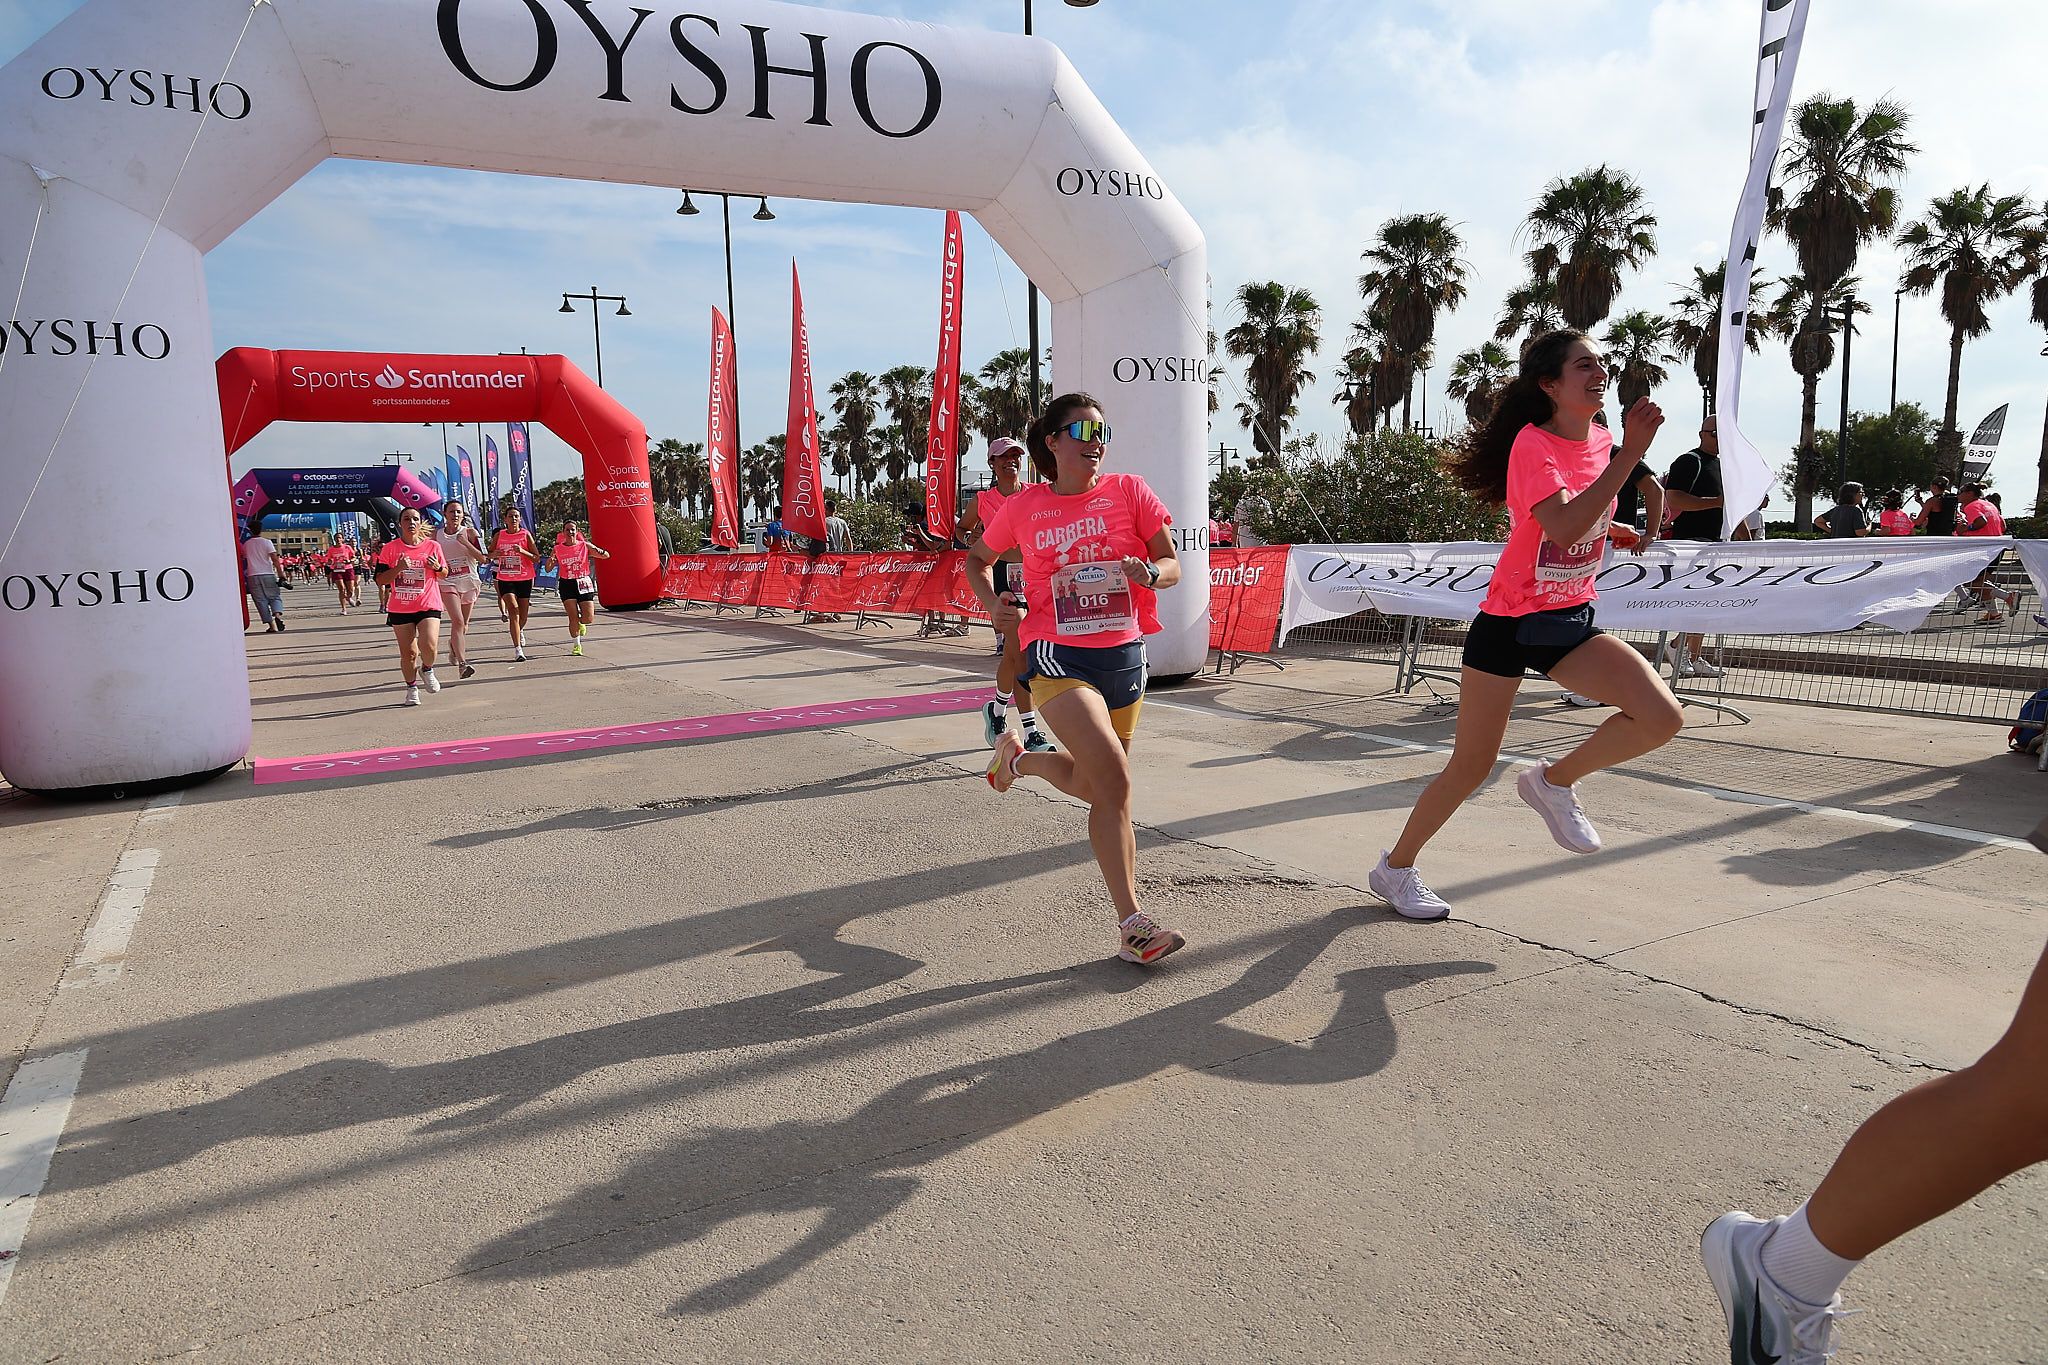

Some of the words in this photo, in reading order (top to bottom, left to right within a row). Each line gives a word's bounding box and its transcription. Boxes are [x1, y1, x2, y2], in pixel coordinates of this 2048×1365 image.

[436, 0, 943, 138] OYSHO
[41, 66, 252, 120] OYSHO
[1056, 167, 1163, 200] OYSHO
[0, 319, 171, 360] YSHO
[291, 366, 371, 393] Sports
[409, 370, 526, 389] Santander
[1112, 356, 1207, 384] OYSHO
[372, 397, 451, 406] sportssantander.es
[338, 473, 365, 482] energy
[609, 465, 639, 477] Sports
[1031, 509, 1061, 521] OYSHO
[1170, 526, 1208, 552] SHO
[1567, 541, 1593, 556] 016
[889, 560, 937, 574] Santander
[1209, 562, 1264, 586] ander
[1308, 557, 1496, 593] OYSHO
[1544, 570, 1572, 578] OYSHO
[1595, 560, 1883, 592] OYSHO
[2, 567, 194, 612] OYSHO
[1079, 593, 1109, 609] 016
[1626, 598, 1759, 609] WWW.OYSHO.COM
[1065, 624, 1090, 632] OYSHO
[747, 703, 898, 724] OYSHO
[537, 723, 709, 745] OYSHO
[291, 746, 491, 771] OYSHO
